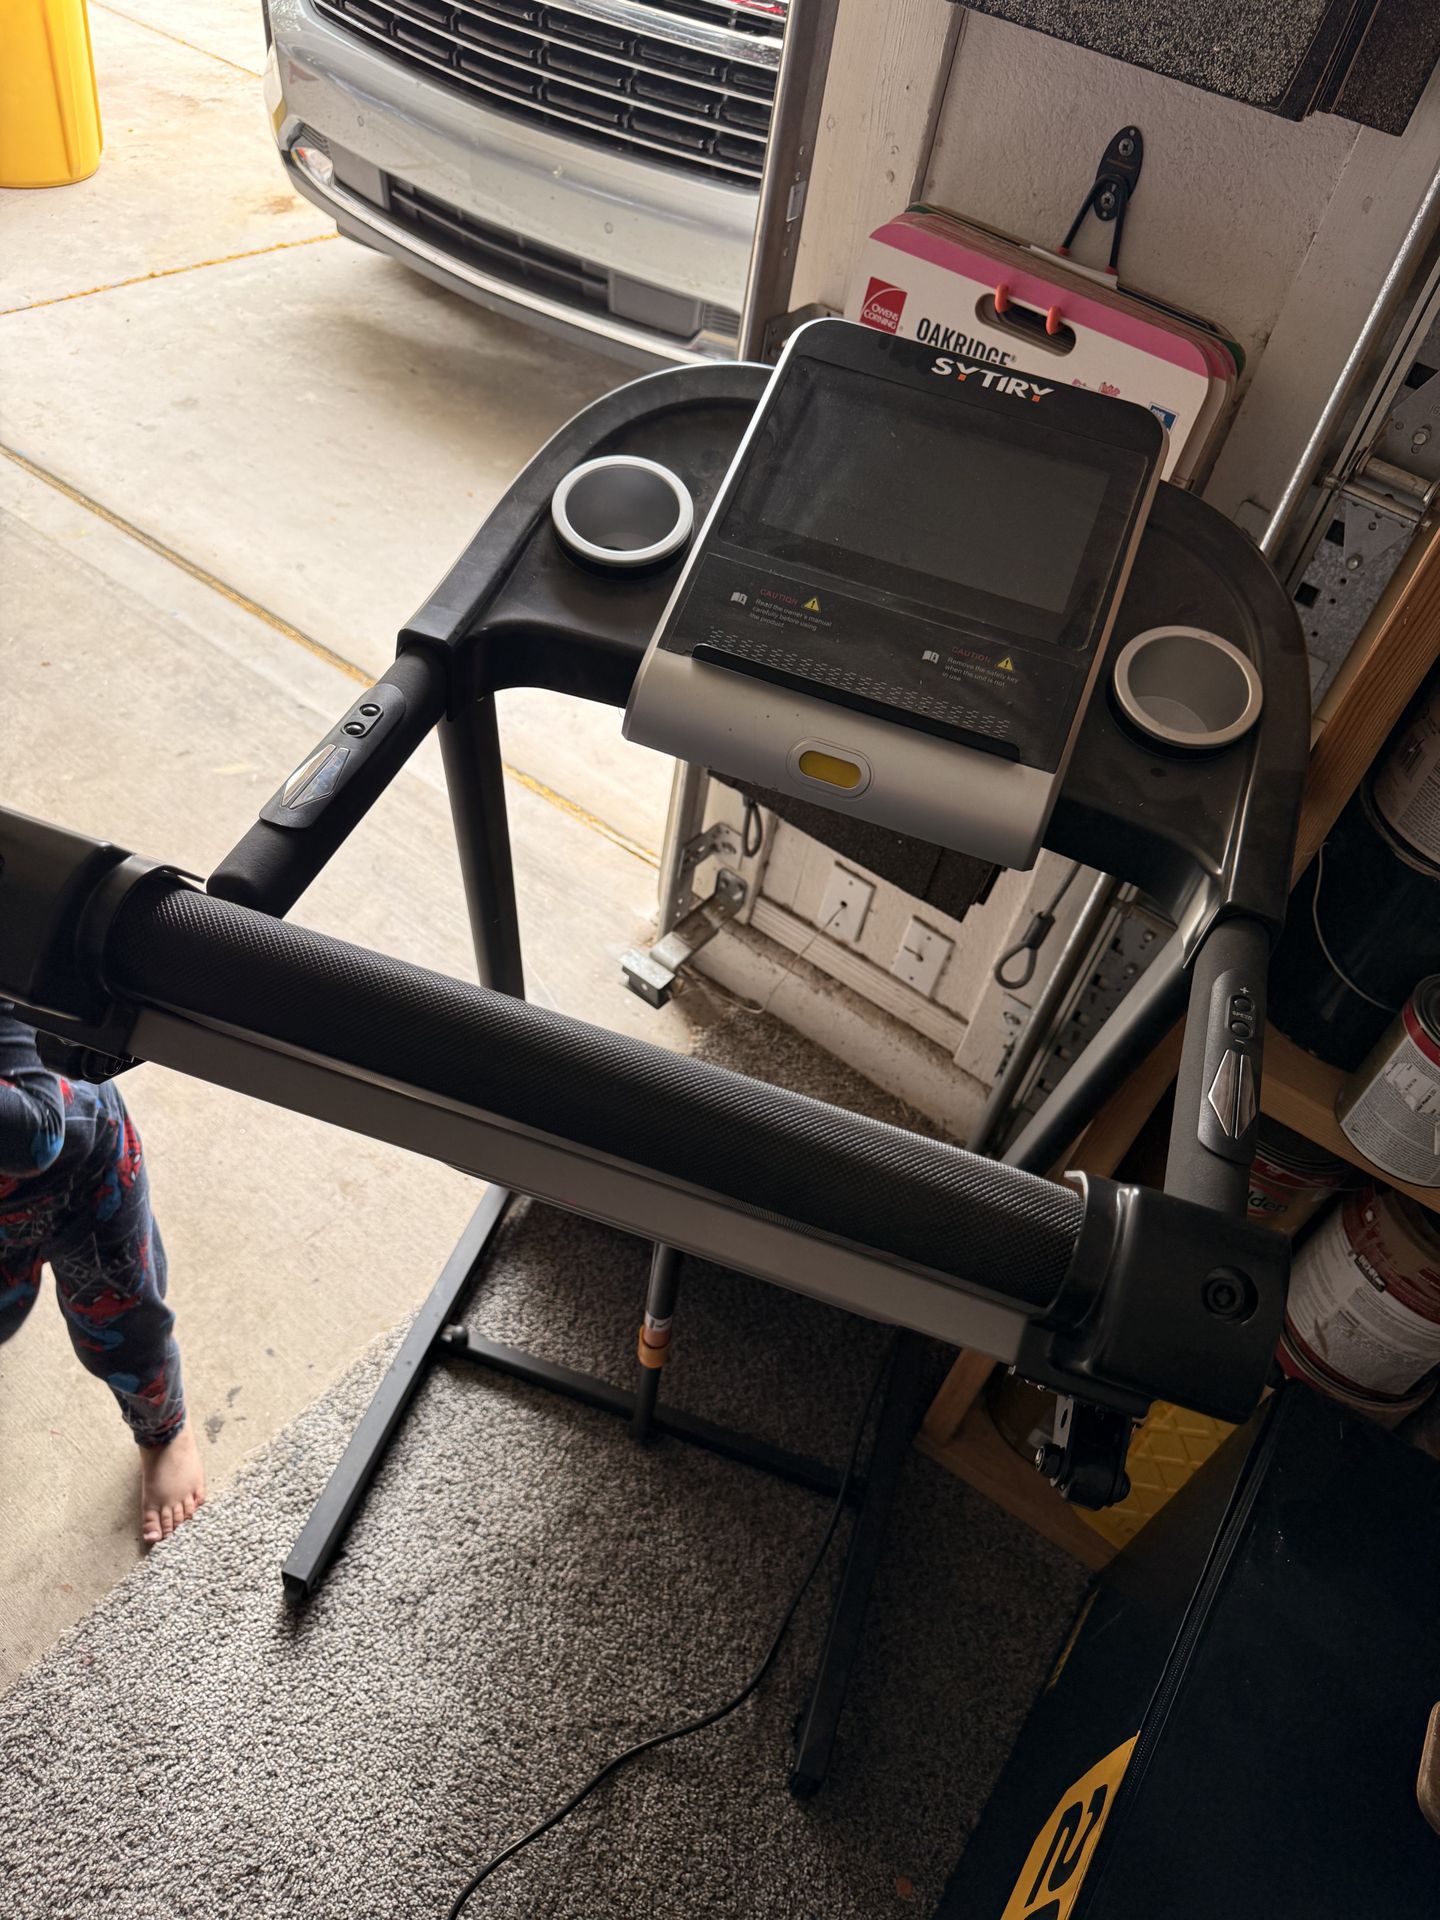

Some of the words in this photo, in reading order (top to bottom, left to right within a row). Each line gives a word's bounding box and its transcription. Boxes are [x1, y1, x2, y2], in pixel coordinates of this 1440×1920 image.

[863, 309, 898, 330] CORNING
[872, 303, 899, 321] OWENS
[930, 357, 1055, 402] SYTIRY
[760, 588, 798, 606] CAUTION
[750, 613, 761, 621] the
[752, 606, 778, 619] carefully
[779, 614, 800, 625] before
[800, 621, 818, 632] using
[755, 599, 773, 609] Read
[773, 604, 784, 612] the
[809, 615, 833, 627] manual
[952, 646, 991, 663] CAUTION
[944, 665, 962, 674] when
[962, 670, 974, 678] the
[974, 674, 989, 682] unit
[994, 680, 1006, 689] not
[947, 657, 974, 670] Remove
[975, 664, 986, 673] the
[986, 670, 1007, 680] safety
[1007, 675, 1019, 684] key
[1232, 1010, 1253, 1021] SPEED
